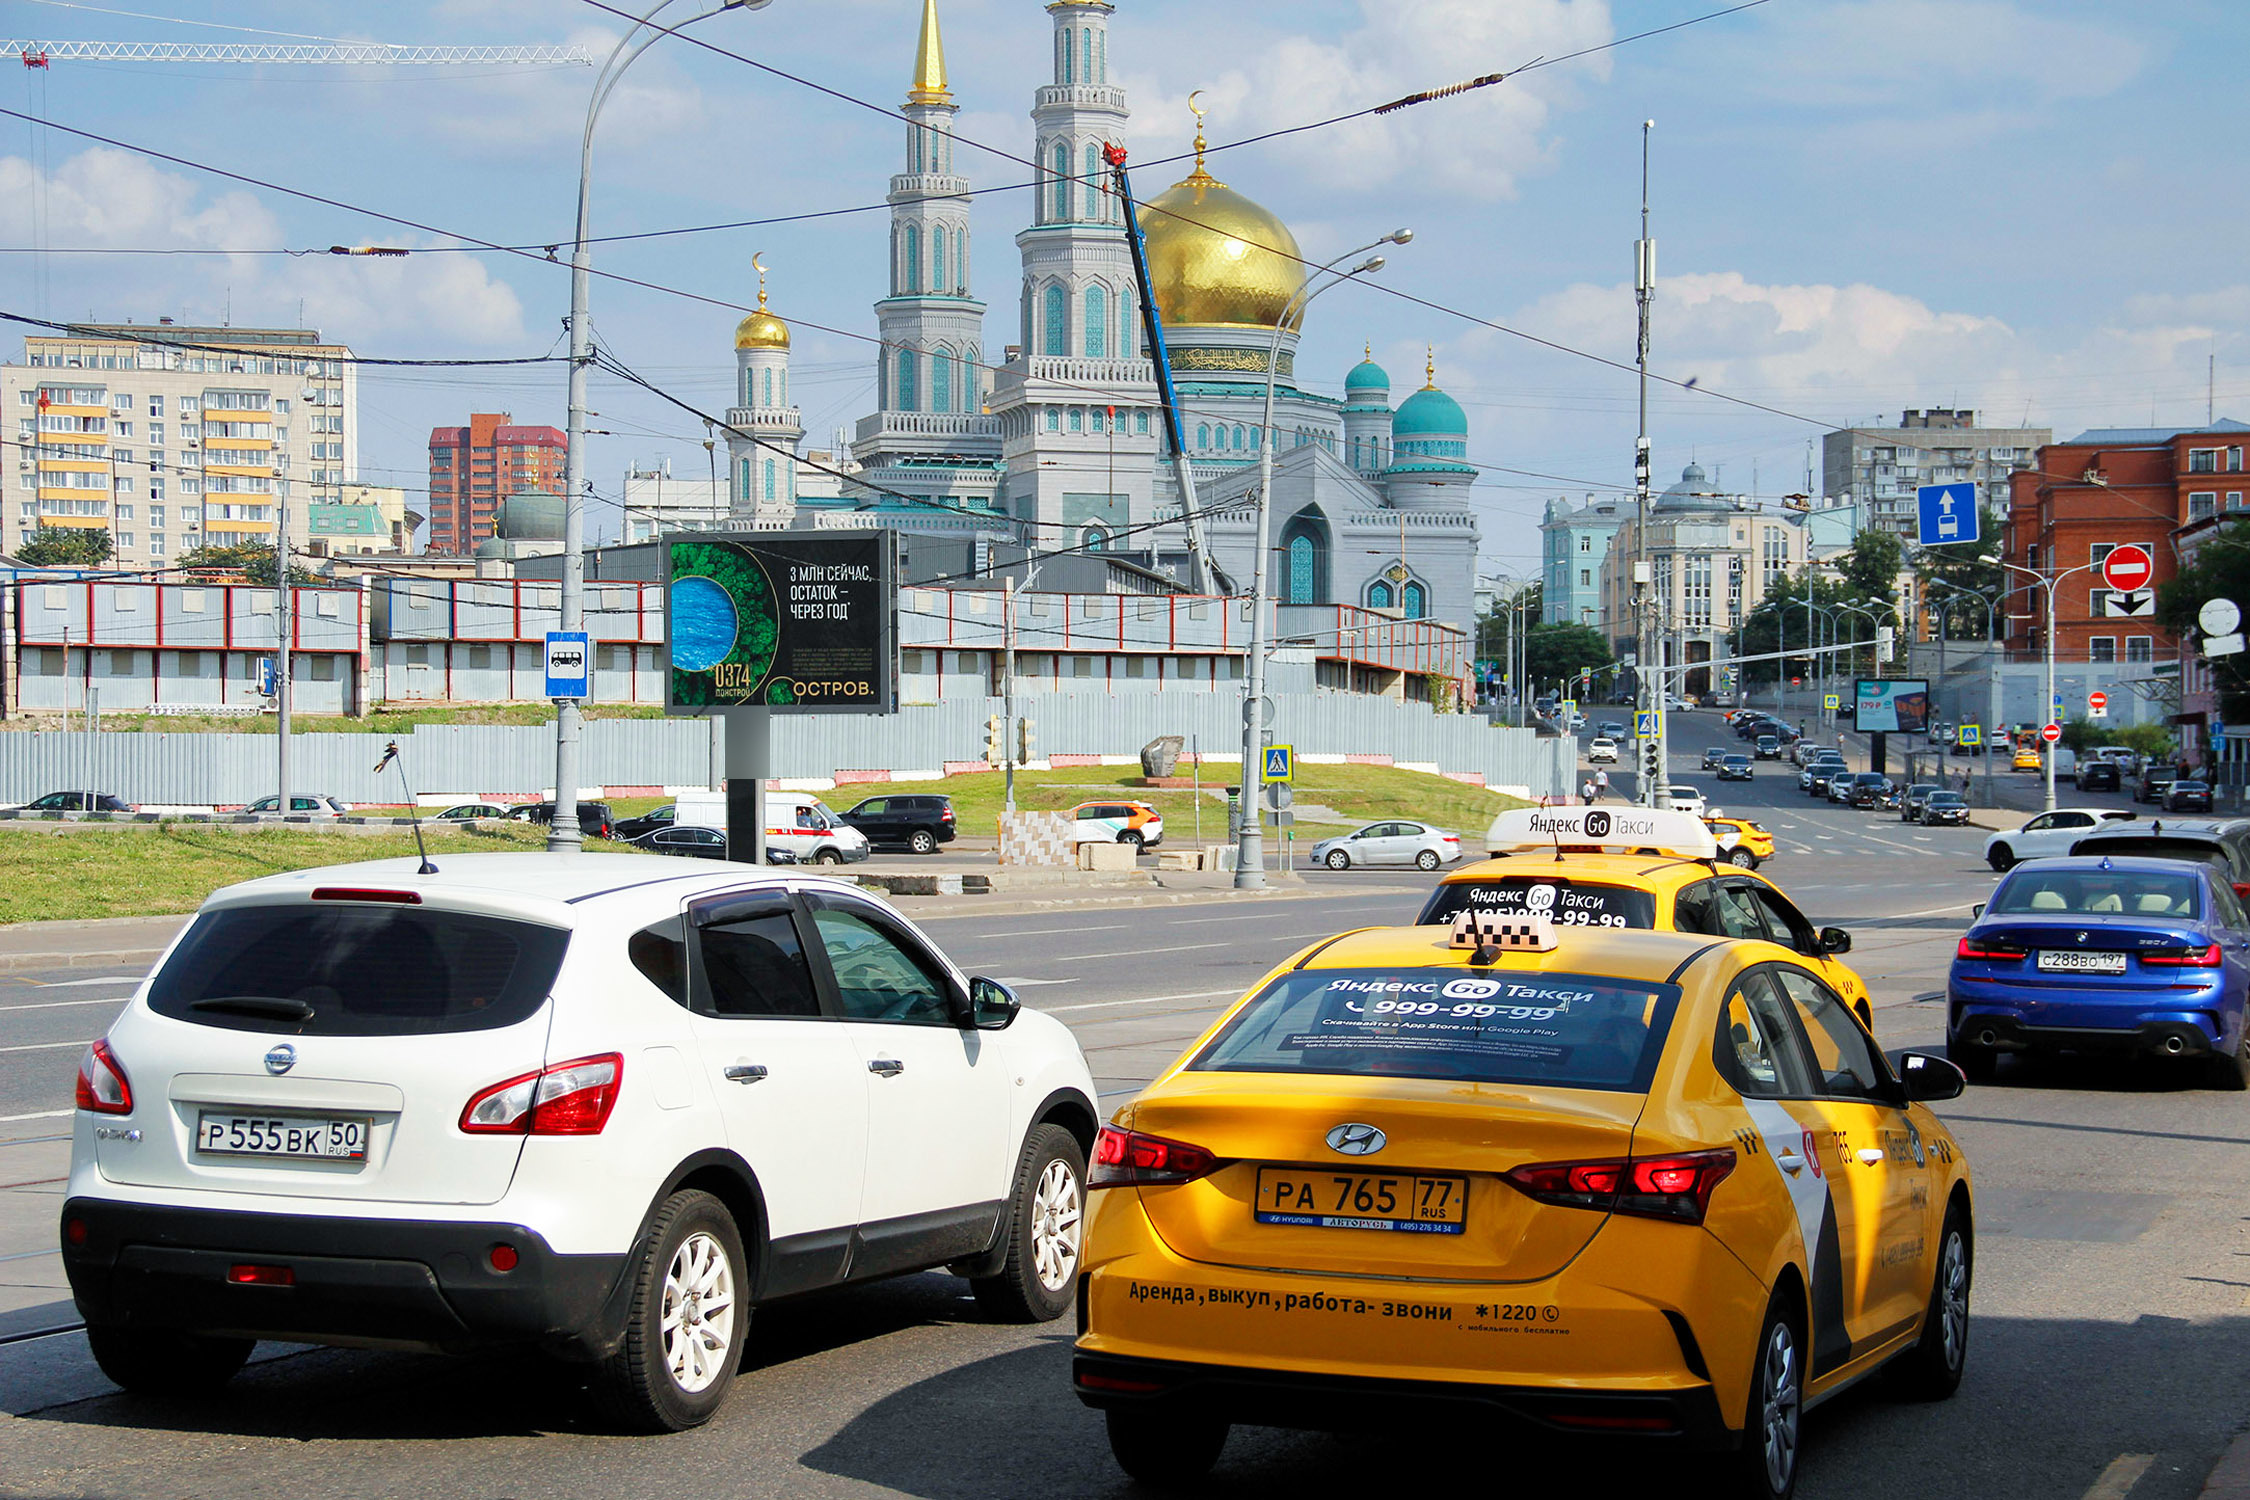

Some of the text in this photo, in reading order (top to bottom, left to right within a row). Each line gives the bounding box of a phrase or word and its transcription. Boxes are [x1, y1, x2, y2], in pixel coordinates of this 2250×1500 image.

[790, 563, 872, 582] 3 МЛН СЕЙЧАС,
[790, 585, 838, 600] ОСТАТОК
[790, 603, 824, 619] ЧЕРЕЗ
[793, 681, 875, 697] ОСТРОВ.
[1529, 813, 1654, 835] Яндекс Go Такси
[1470, 887, 1605, 910] Яндекс Go Такси
[2101, 953, 2122, 965] 197
[1326, 979, 1594, 1002] Яндекс Go Такси
[1373, 1000, 1555, 1021] 999-99-99
[1322, 1018, 1390, 1028] Скачивайте
[1401, 1022, 1426, 1030] App
[1428, 1022, 1460, 1030] Store
[1461, 1024, 1485, 1032] или
[1487, 1025, 1531, 1035] Google
[1533, 1028, 1559, 1037] Play
[330, 1122, 359, 1147] 50
[328, 1146, 349, 1156] RUS
[1833, 1130, 1853, 1165] 765
[1333, 1177, 1398, 1213] 765
[1419, 1180, 1453, 1207] 77
[1421, 1208, 1446, 1219] RUS
[1282, 1216, 1313, 1224] HYUNDAI
[1330, 1217, 1387, 1229] АВТОРУСЬ
[1400, 1223, 1418, 1231] (495)
[1419, 1224, 1432, 1232] 276
[1381, 1301, 1452, 1320] звони
[1468, 1323, 1520, 1334] мобильного
[1524, 1326, 1570, 1335] бесплатно
